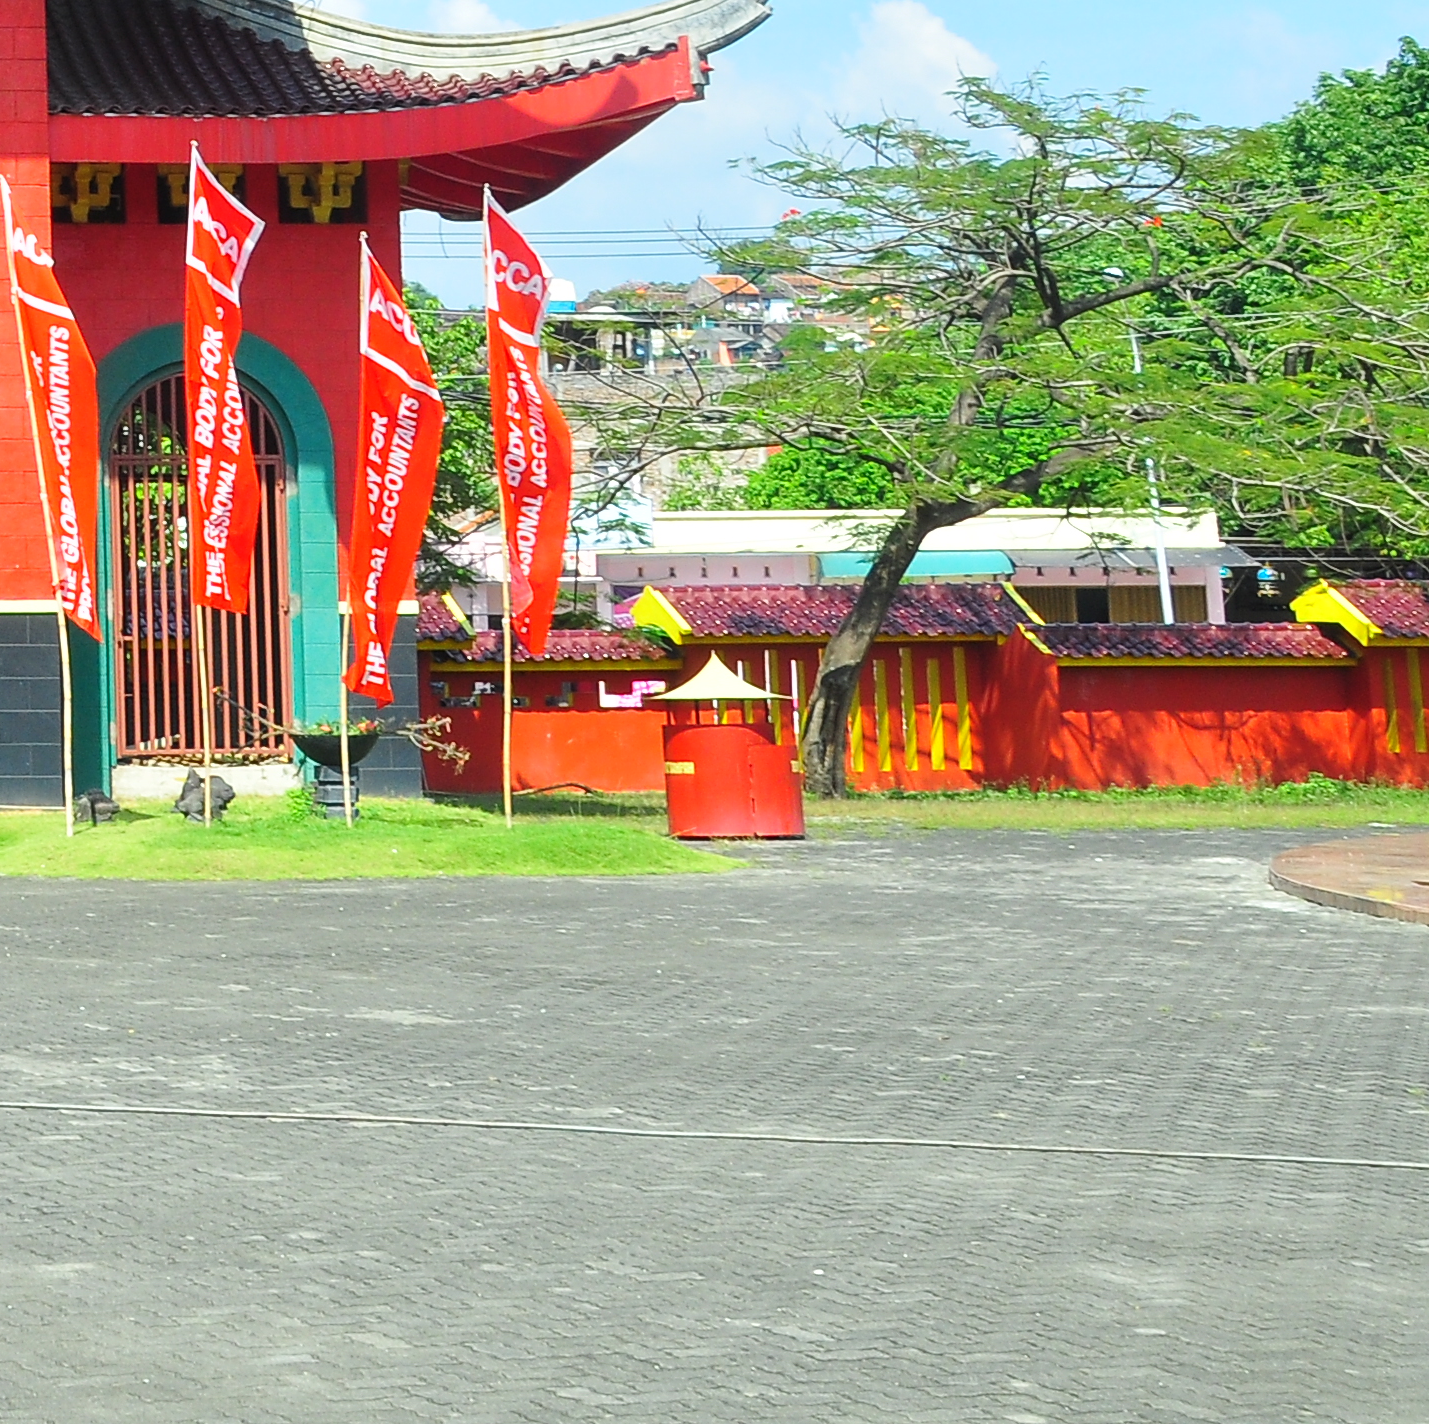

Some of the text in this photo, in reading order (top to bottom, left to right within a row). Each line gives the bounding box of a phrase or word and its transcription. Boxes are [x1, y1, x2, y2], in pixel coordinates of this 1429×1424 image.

[491, 249, 543, 303] CCA
[369, 287, 422, 346] ACC
[200, 324, 224, 380] FOR
[195, 375, 218, 449] BODY
[377, 393, 420, 538] ACCOUNTANTS
